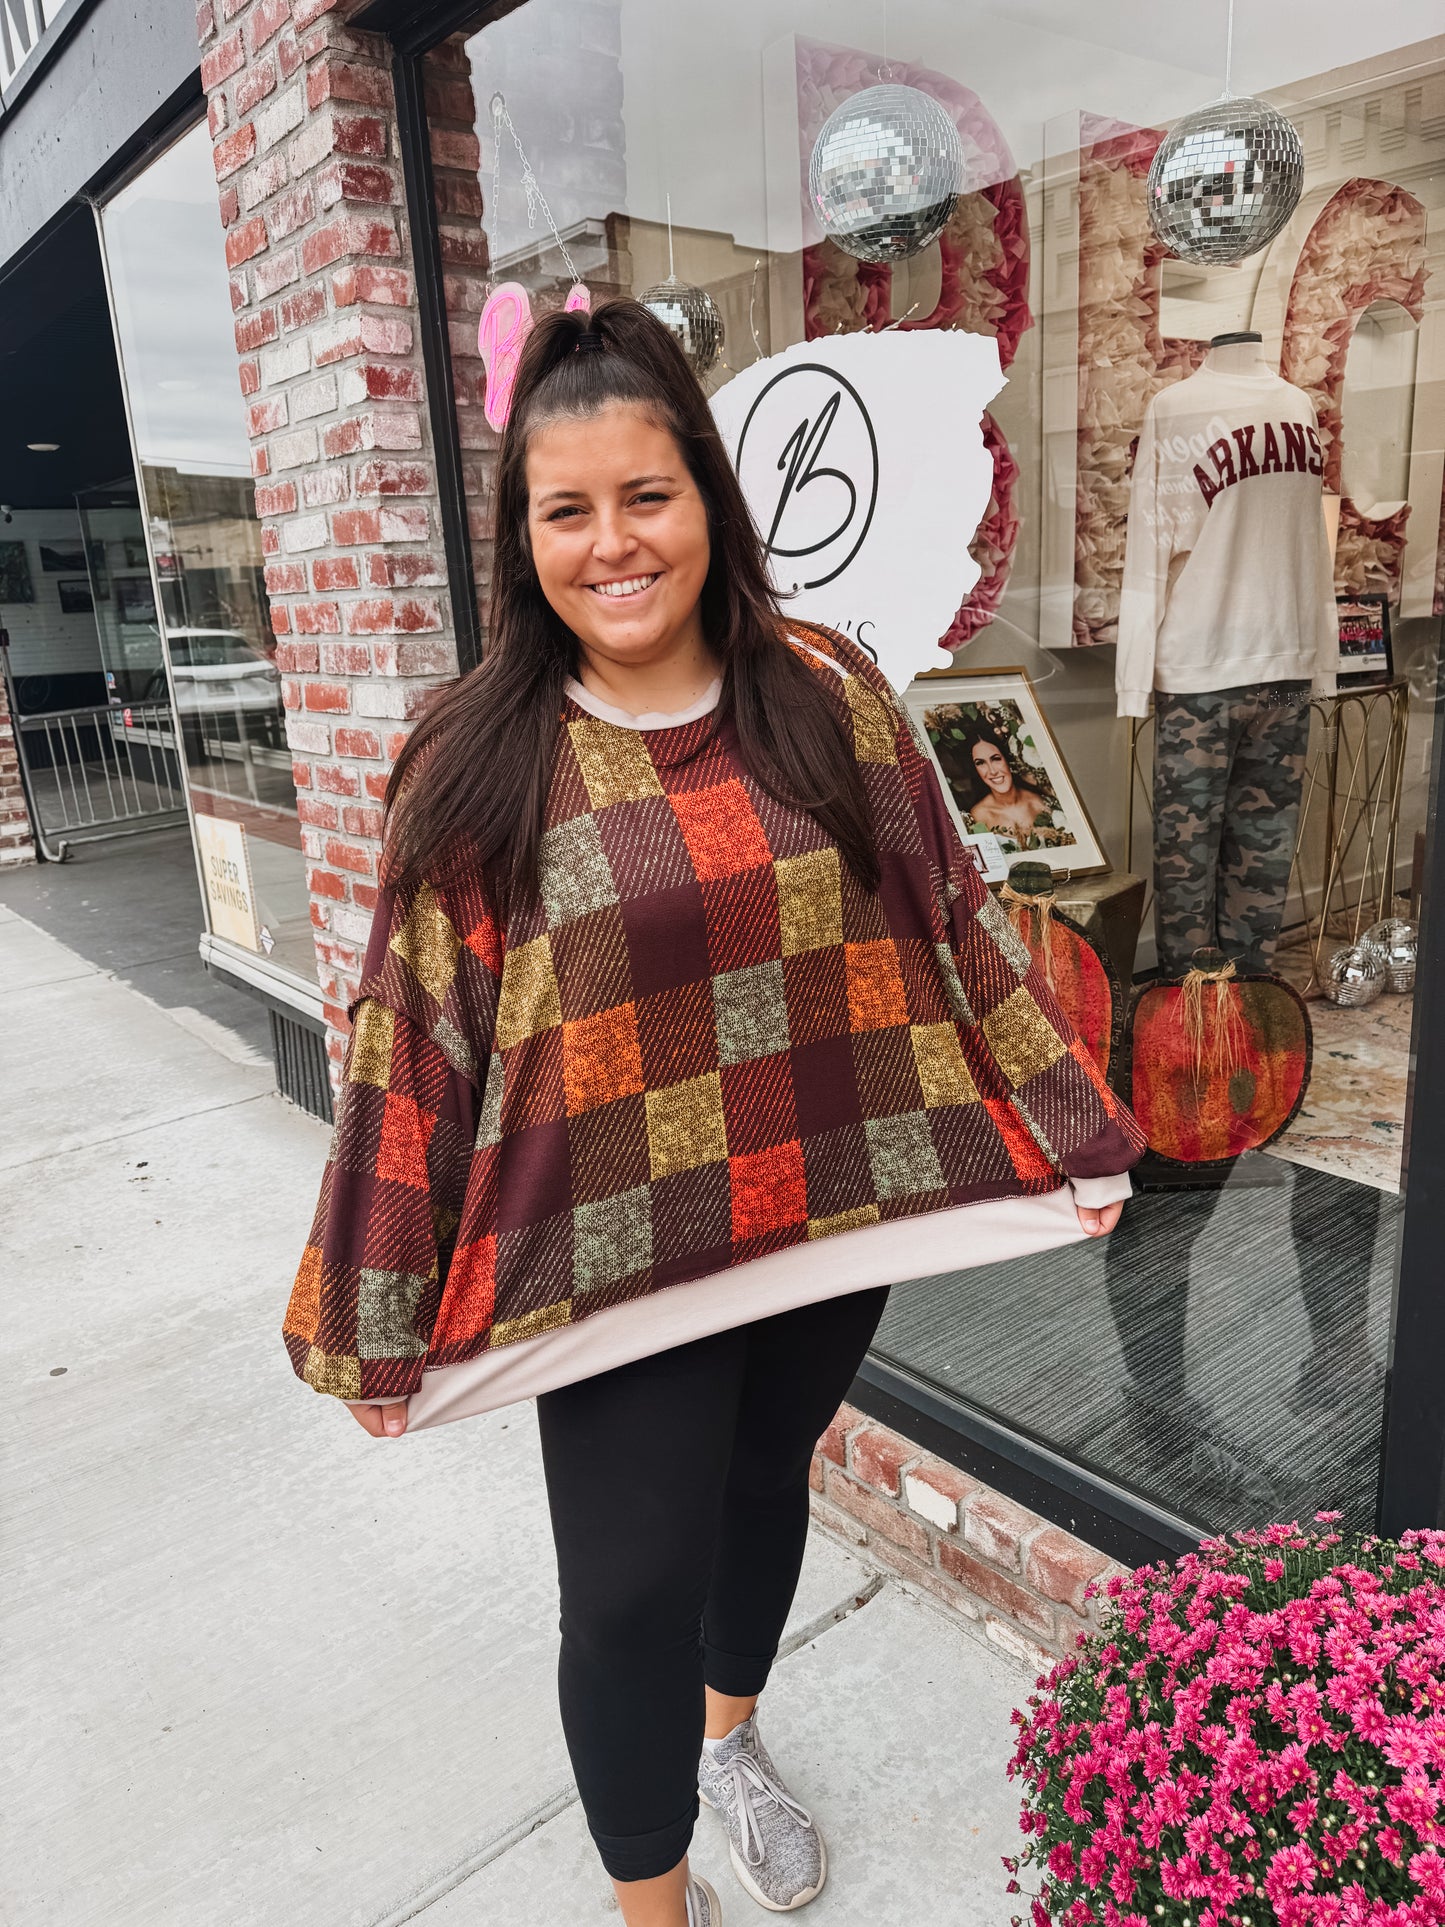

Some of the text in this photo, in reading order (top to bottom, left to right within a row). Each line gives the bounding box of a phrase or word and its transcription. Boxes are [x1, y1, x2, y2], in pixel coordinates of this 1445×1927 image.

[1193, 421, 1323, 510] ARKANS
[211, 856, 240, 884] SUPER
[210, 880, 249, 913] SAVINGS
